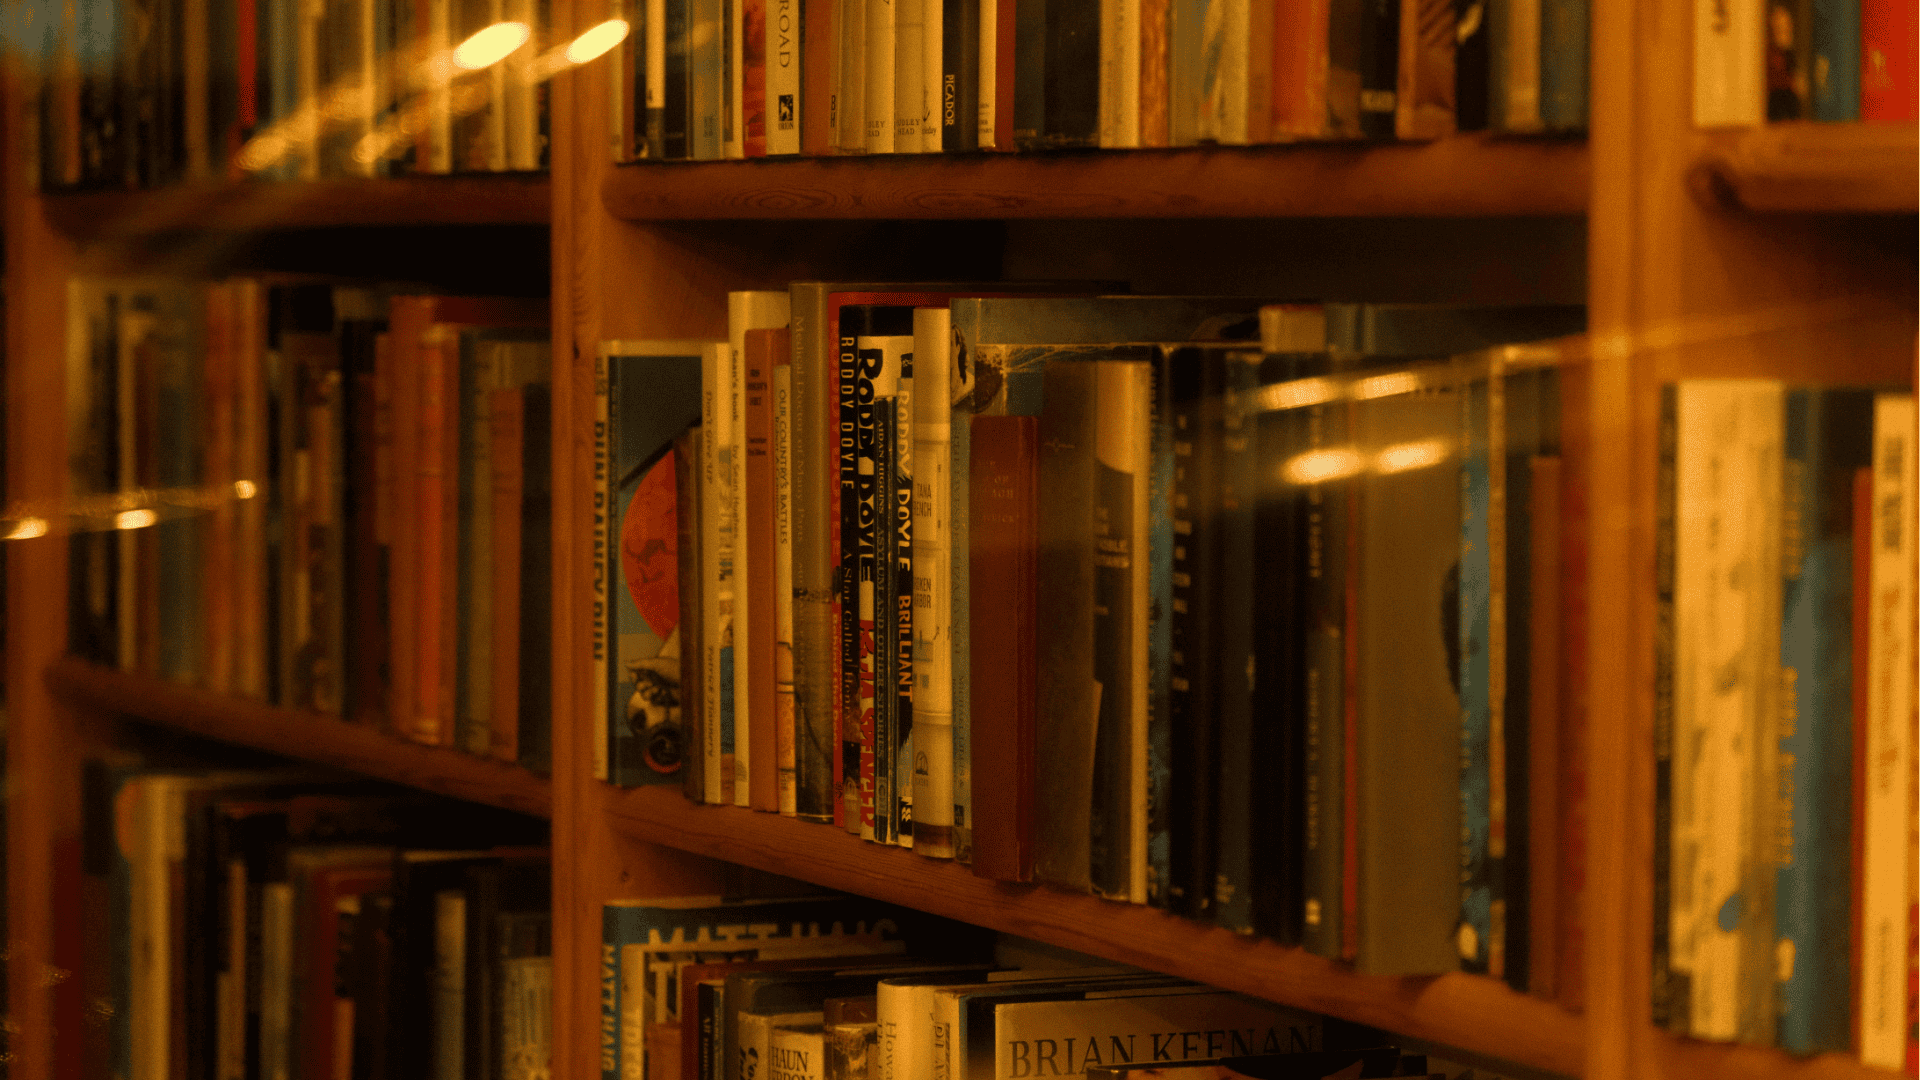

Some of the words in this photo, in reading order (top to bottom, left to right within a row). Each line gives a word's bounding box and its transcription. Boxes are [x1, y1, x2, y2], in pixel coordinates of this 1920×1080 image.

[944, 74, 955, 126] PICADOR
[795, 316, 805, 375] Medical
[841, 337, 855, 409] RODDY
[780, 389, 788, 417] OUR
[859, 348, 884, 459] RODDY
[779, 421, 789, 489] COUNTRY'S
[841, 422, 855, 490] DOYLE
[877, 420, 885, 459] AIDAN
[897, 390, 912, 478] RODDY
[877, 462, 885, 514] HIGGINS
[779, 494, 788, 544] BATTLES
[859, 474, 875, 583] DOYLE
[897, 488, 912, 573] DOYLE
[844, 567, 853, 603] Star
[876, 525, 885, 588] ASYLUM
[844, 610, 854, 663] Called
[876, 592, 885, 628] AND
[876, 634, 885, 687] OTHER
[898, 595, 914, 703] BRILLIANT
[876, 692, 885, 758] STORIES
[1008, 1033, 1137, 1079] BRIAN
